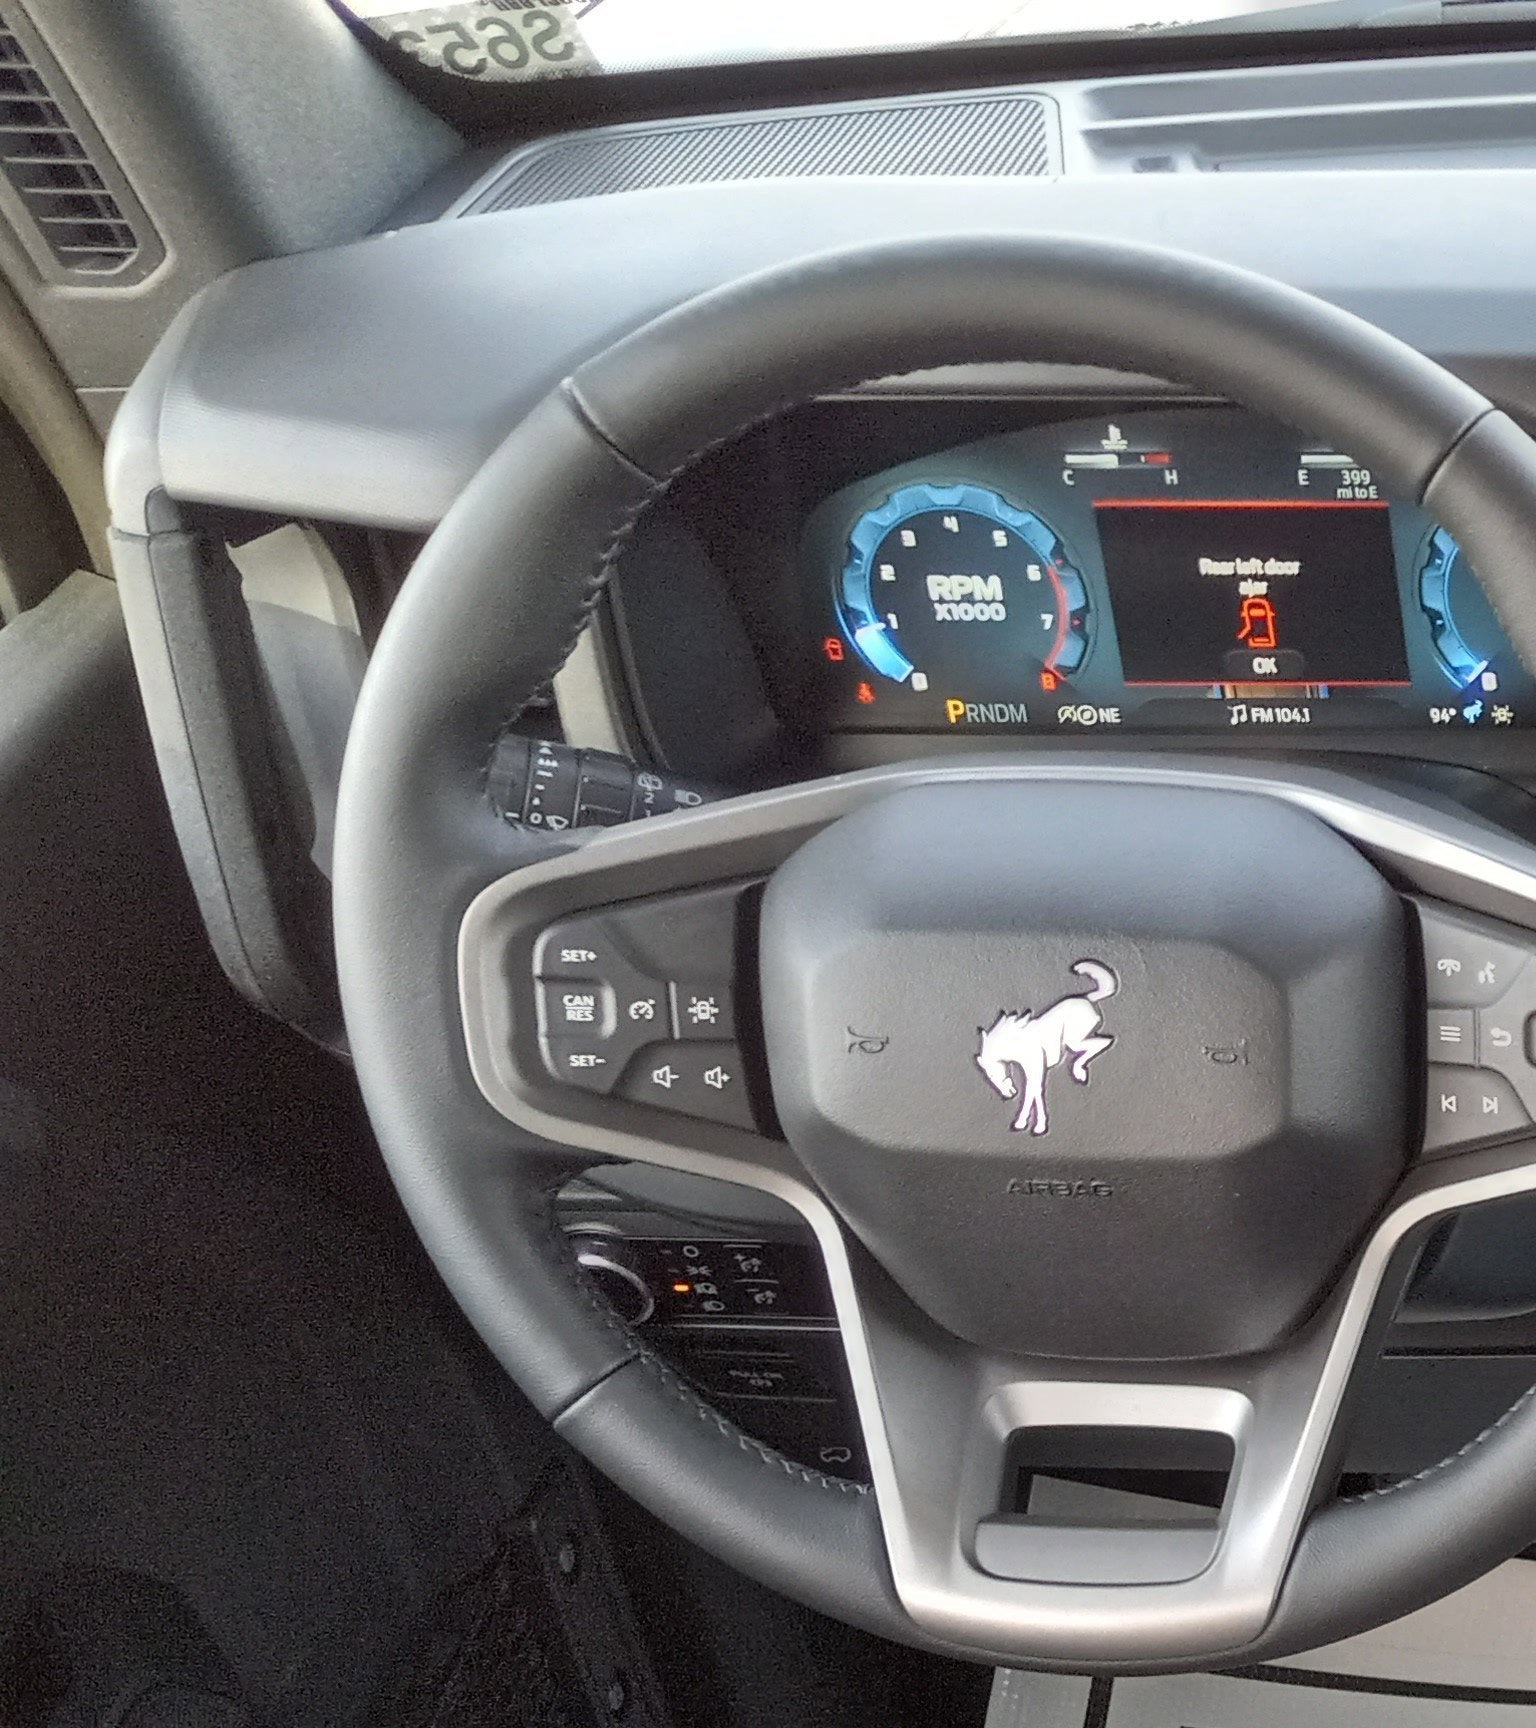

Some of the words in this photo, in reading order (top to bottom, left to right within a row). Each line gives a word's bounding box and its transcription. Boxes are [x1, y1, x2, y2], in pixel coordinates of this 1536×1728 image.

[1063, 470, 1075, 485] C
[1165, 470, 1178, 485] H
[1298, 470, 1309, 485] E
[1341, 470, 1370, 485] 399
[1337, 488, 1353, 499] mi
[1355, 488, 1368, 499] to
[943, 516, 959, 532] 4
[901, 530, 916, 547] 3
[993, 530, 1008, 547] 5
[880, 564, 896, 581] 2
[1027, 564, 1041, 581] 6
[1264, 558, 1300, 576] door
[927, 575, 1003, 601] RPM
[887, 613, 898, 629] 1
[1041, 614, 1053, 630] 7
[1253, 657, 1278, 675] OK
[1099, 708, 1121, 723] NE
[1251, 707, 1273, 723] FM
[1275, 707, 1310, 723] 104.1
[562, 995, 595, 1006] CAN
[566, 1010, 594, 1022] RES
